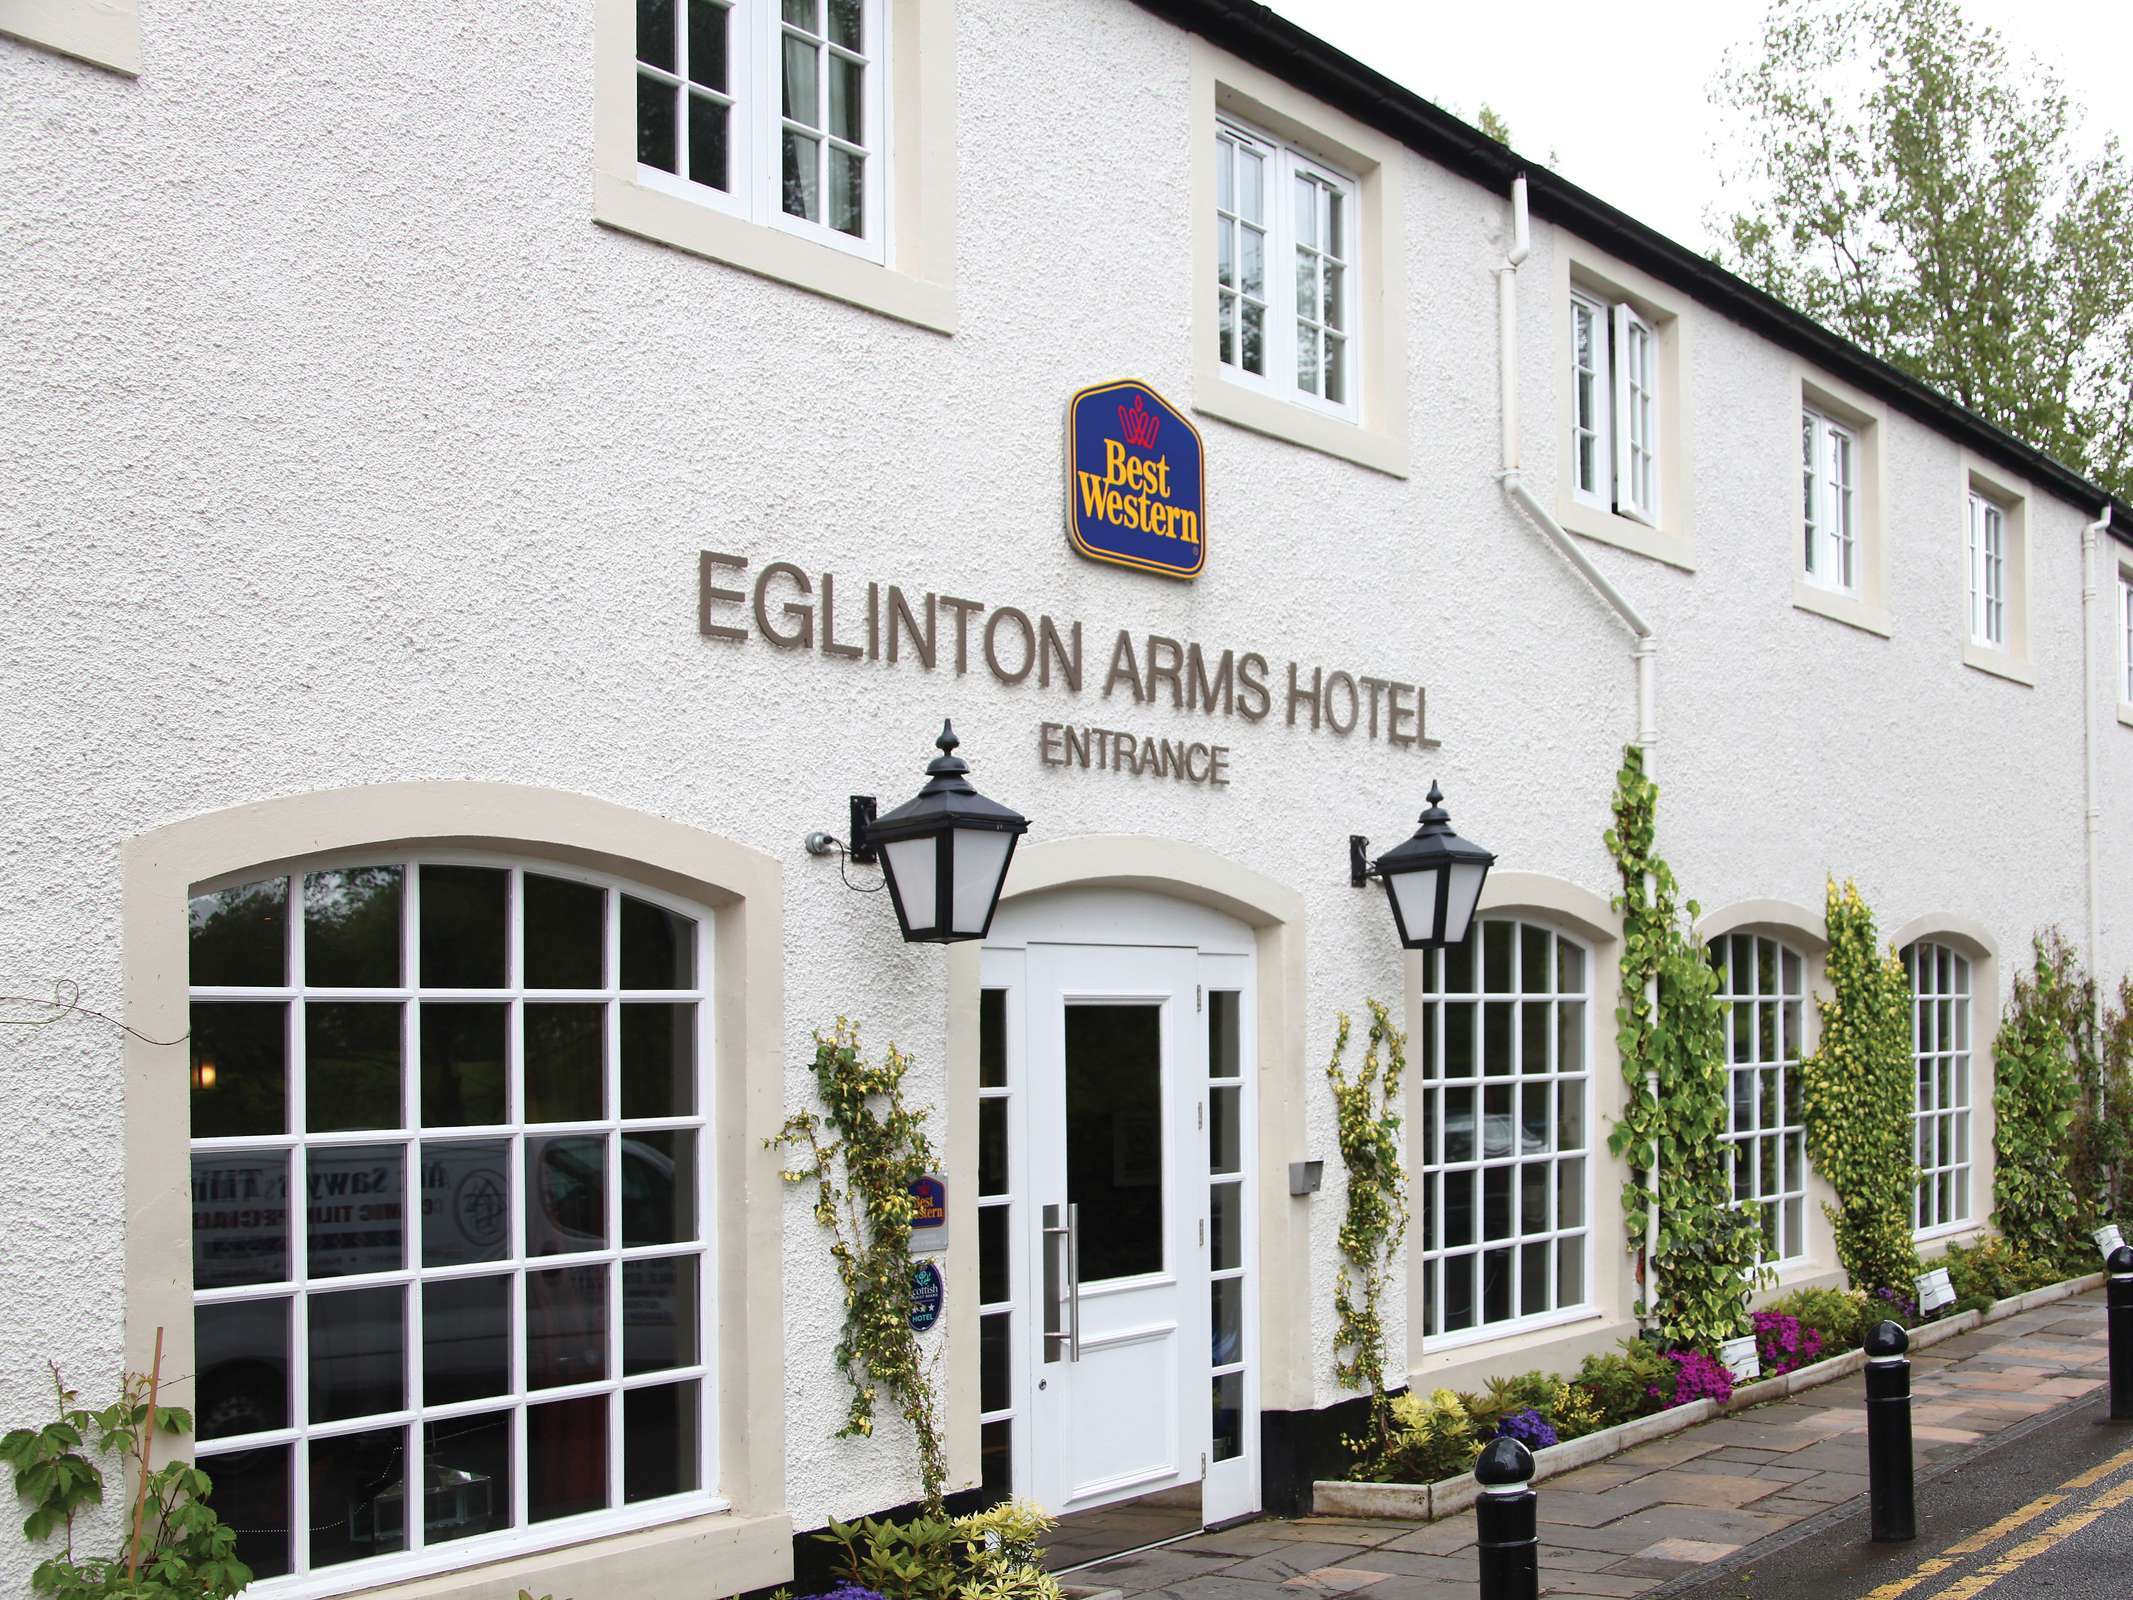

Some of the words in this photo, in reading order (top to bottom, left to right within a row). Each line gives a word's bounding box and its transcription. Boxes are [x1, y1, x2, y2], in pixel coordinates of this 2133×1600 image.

[1104, 438, 1171, 498] Best
[1078, 470, 1199, 544] Western
[700, 549, 1082, 692] EGLINTON
[1103, 629, 1271, 723] ARMS
[1286, 661, 1441, 750] HOTEL
[1041, 721, 1230, 786] ENTRANCE
[911, 1283, 938, 1296] cottish
[912, 1313, 935, 1323] HOTEL
